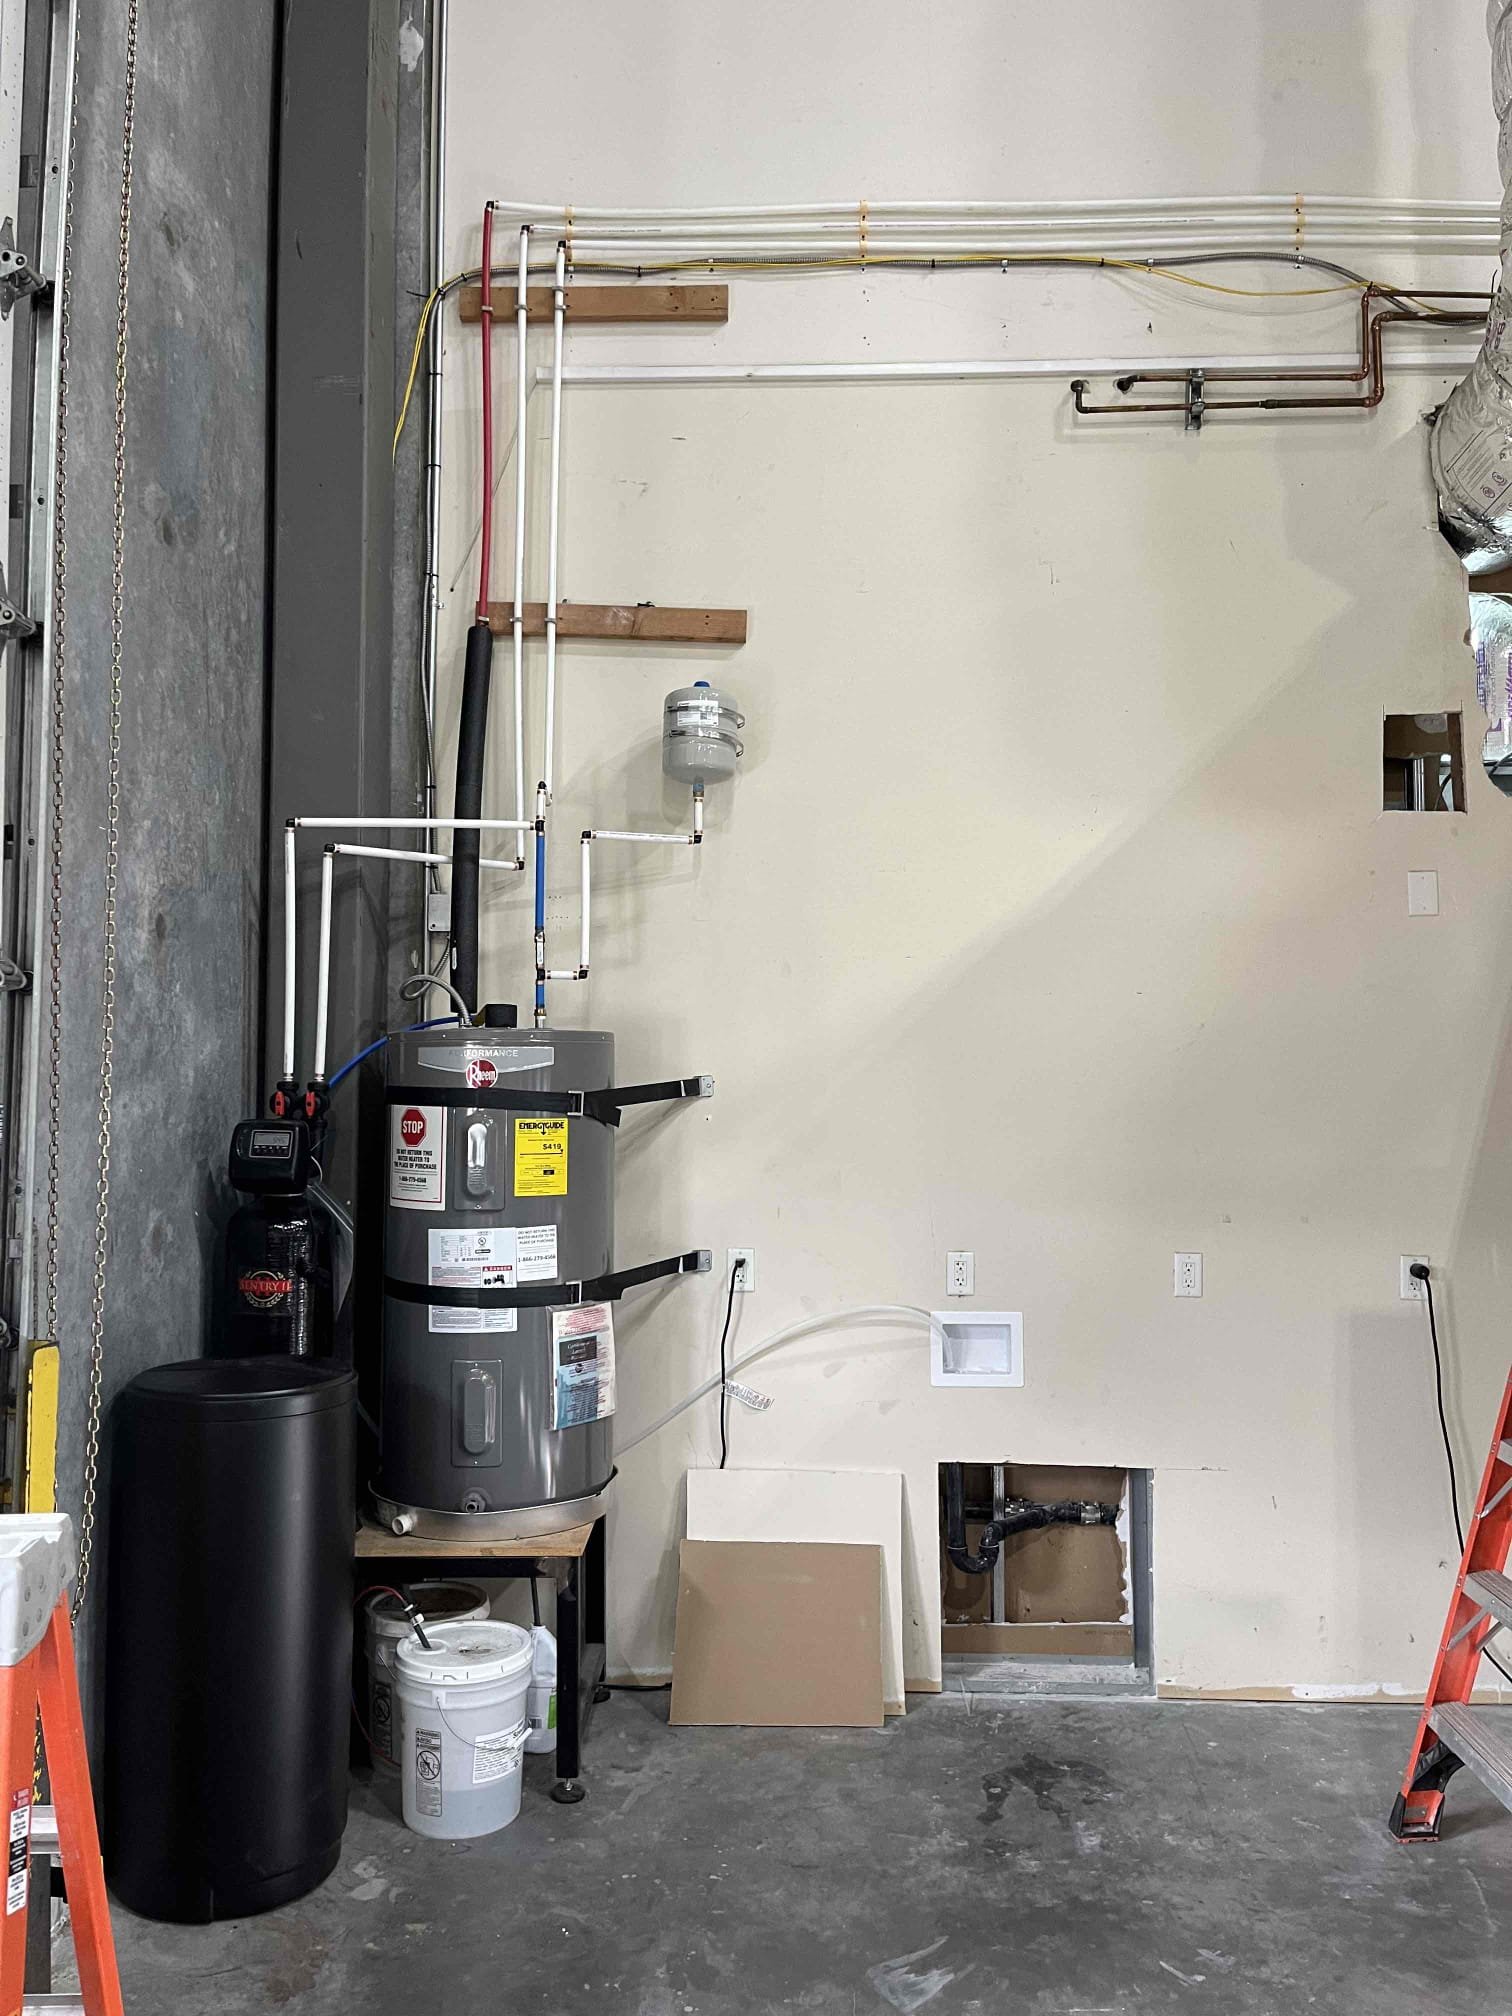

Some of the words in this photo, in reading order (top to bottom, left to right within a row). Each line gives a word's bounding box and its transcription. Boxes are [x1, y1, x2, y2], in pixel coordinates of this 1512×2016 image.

[448, 1049, 519, 1057] FORMANCE
[468, 1060, 496, 1086] Rheem
[403, 1121, 424, 1133] STOP
[519, 1121, 565, 1130] ENERGYGUIDE
[542, 1143, 562, 1151] $419
[240, 1281, 279, 1291] SENTRY
